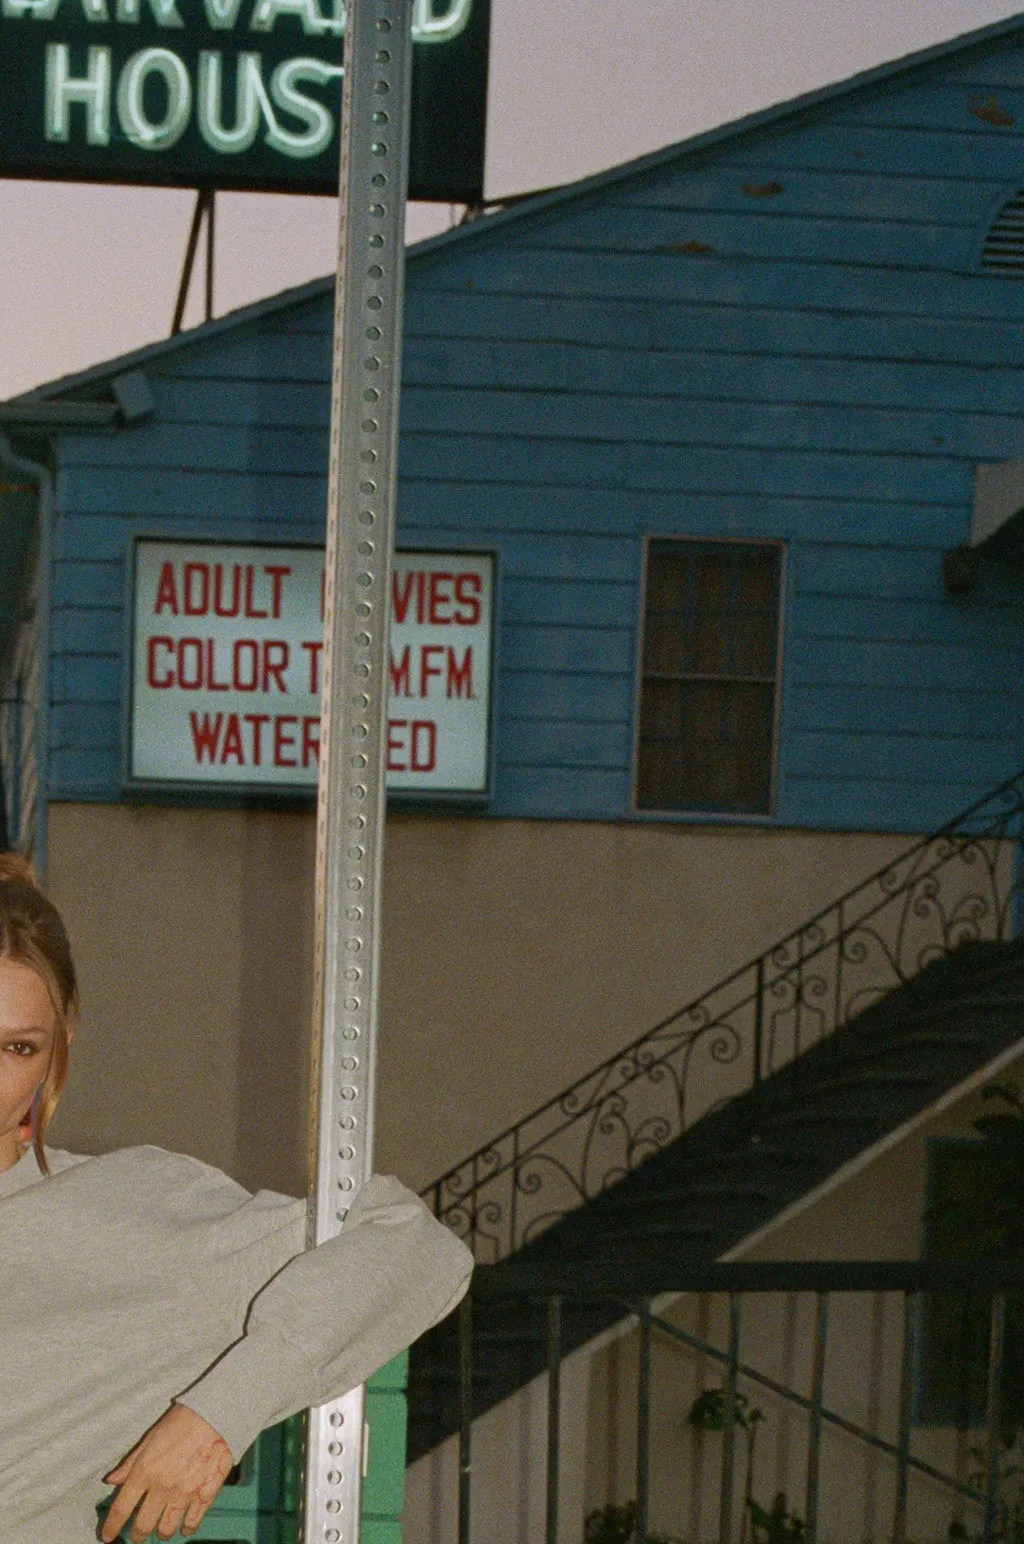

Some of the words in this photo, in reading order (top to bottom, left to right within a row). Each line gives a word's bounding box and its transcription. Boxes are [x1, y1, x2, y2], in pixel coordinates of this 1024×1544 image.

[45, 44, 344, 157] HOUS
[153, 561, 291, 619] ADULT
[321, 566, 482, 626] VIES
[145, 635, 289, 694] COLOR
[301, 641, 325, 695] T
[386, 719, 437, 773] ED
